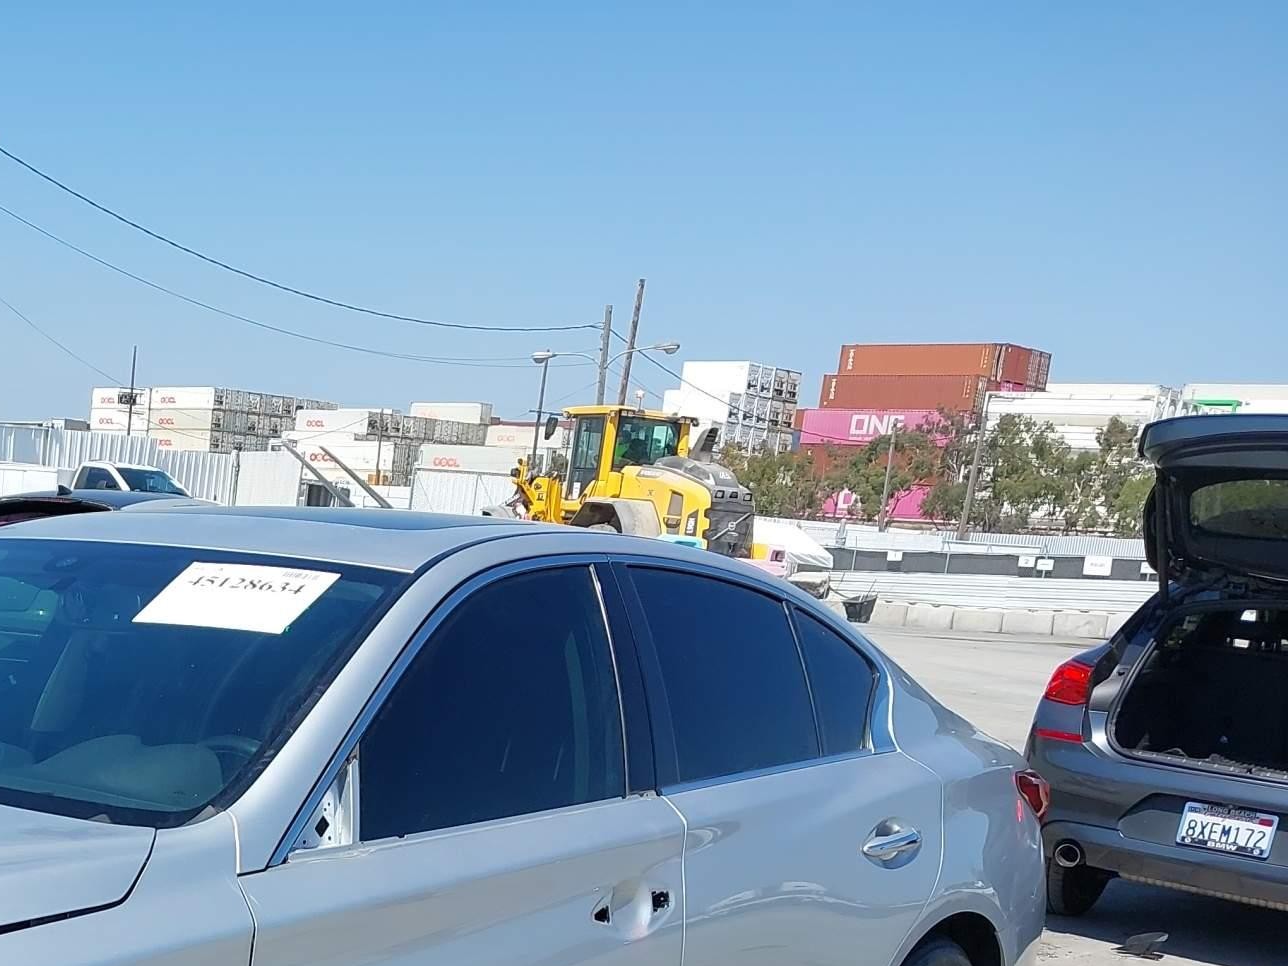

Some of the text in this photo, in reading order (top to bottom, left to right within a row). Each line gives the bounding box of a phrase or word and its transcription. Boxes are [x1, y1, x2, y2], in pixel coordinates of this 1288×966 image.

[306, 419, 325, 427] OOCL
[433, 457, 460, 467] OOCL
[187, 575, 306, 595] 45128634
[1207, 804, 1229, 815] LONG
[1230, 808, 1257, 819] BEACH
[1185, 818, 1266, 849] 8XEM172
[1206, 840, 1239, 851] BMW
